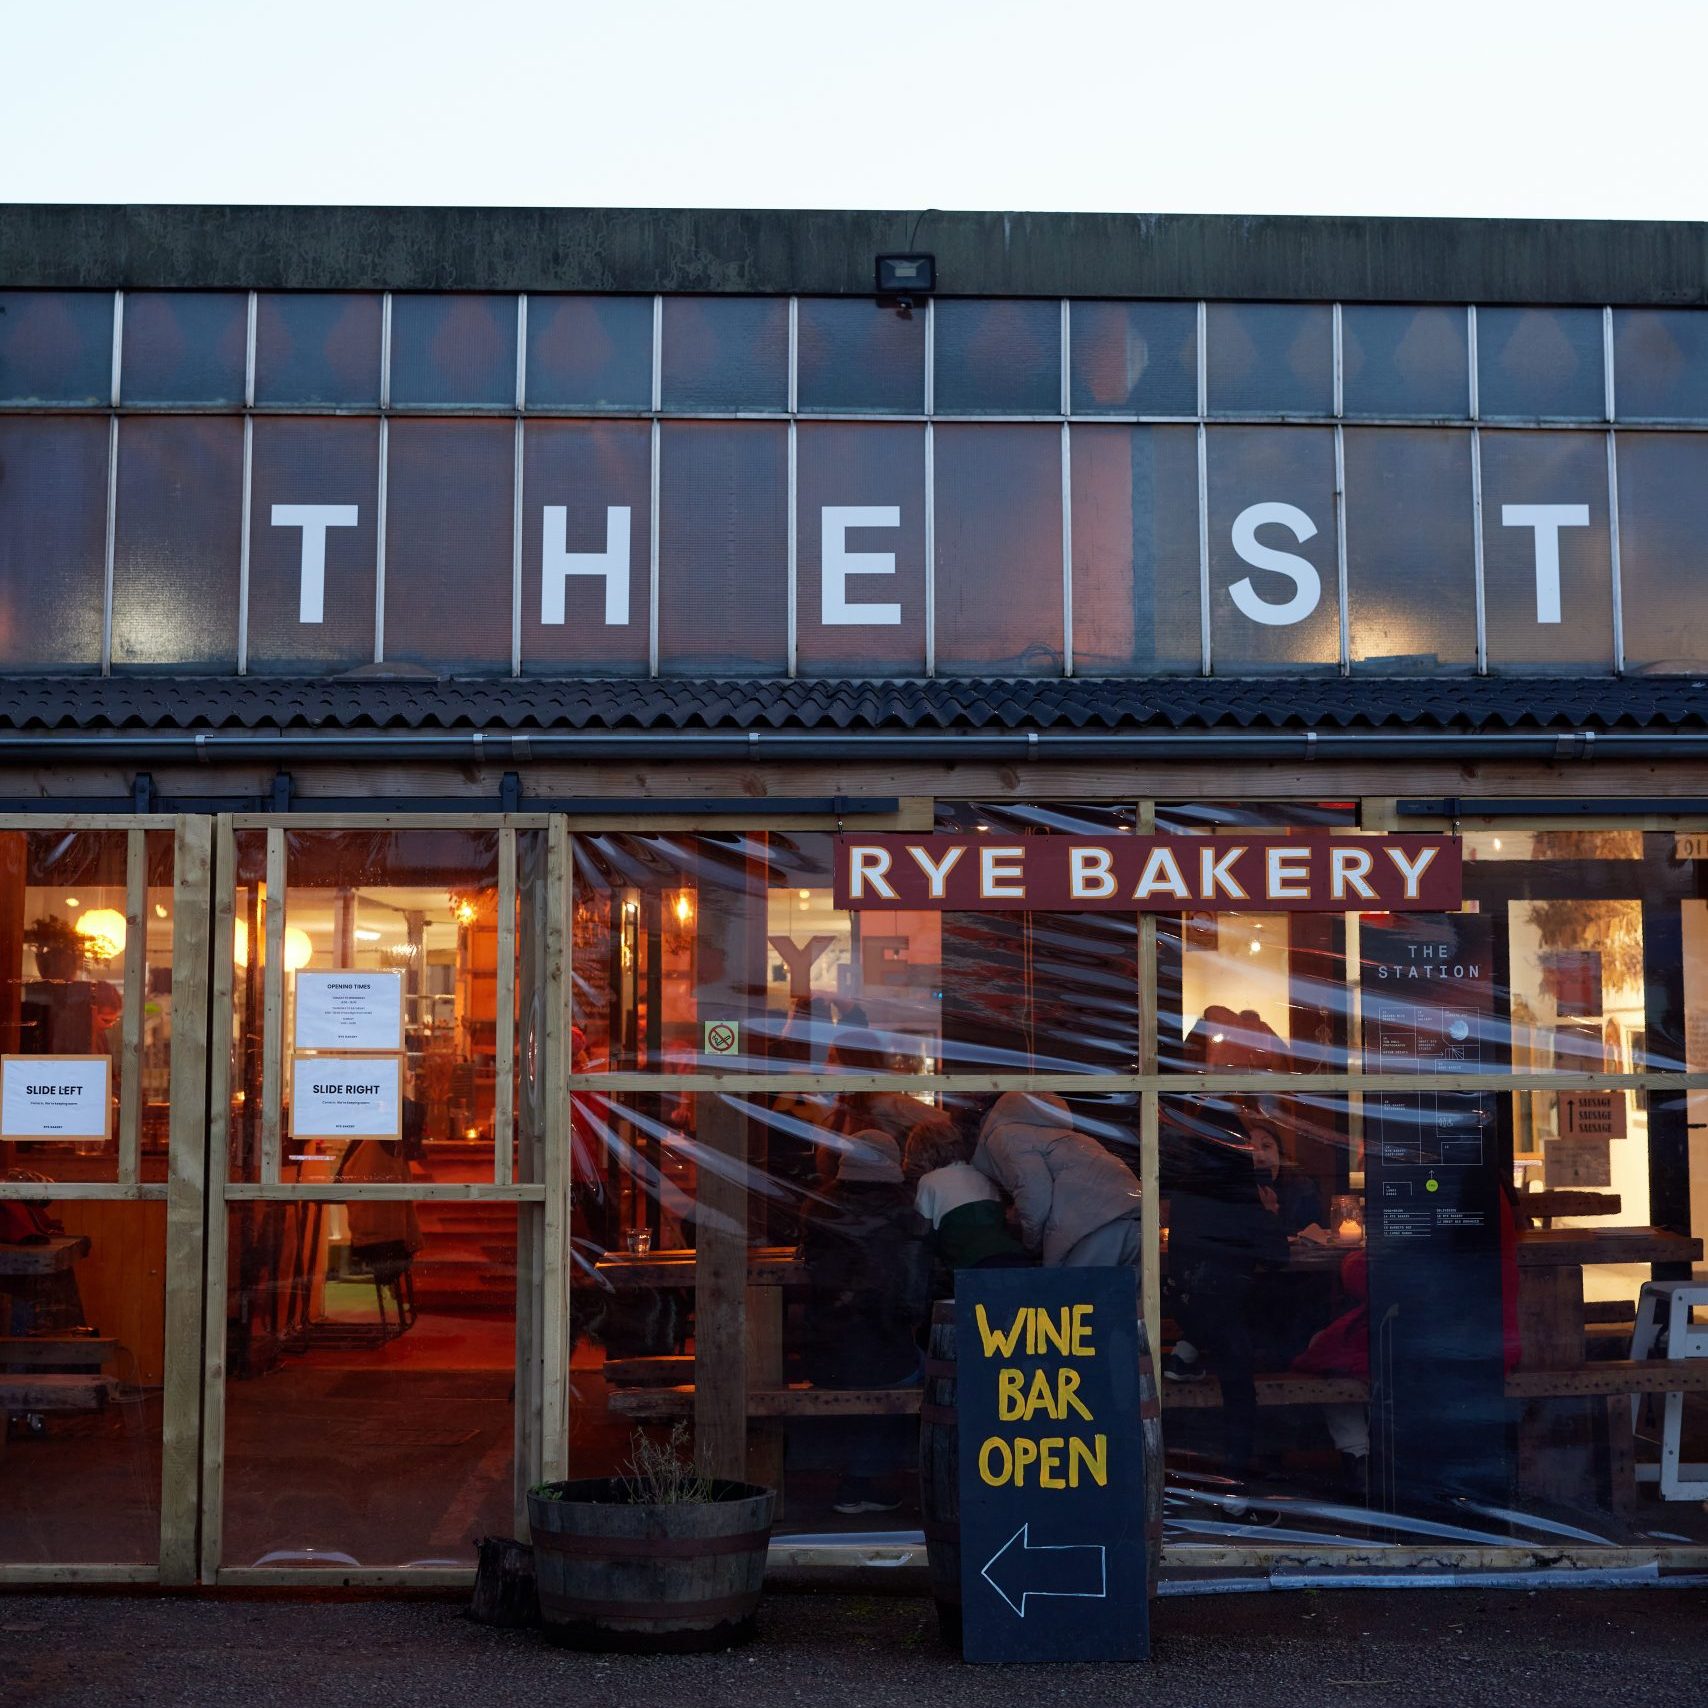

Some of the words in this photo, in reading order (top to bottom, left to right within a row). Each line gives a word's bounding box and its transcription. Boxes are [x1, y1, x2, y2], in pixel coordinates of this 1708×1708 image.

[270, 504, 903, 626] THE
[1229, 502, 1590, 626] ST
[848, 845, 1026, 900] RYE
[1069, 846, 1442, 900] BAKERY
[1408, 945, 1448, 958] THE
[1378, 965, 1479, 979] STATION
[26, 1085, 56, 1095] SLIDE
[58, 1086, 83, 1095] LEFT
[313, 1084, 343, 1094] SLIDE
[345, 1085, 380, 1095] RIGHT
[1579, 1098, 1611, 1107] SAUSAGE
[1579, 1111, 1611, 1120] SAUSAGE
[1579, 1124, 1612, 1133] SAUSAGE
[975, 1304, 1096, 1358] WINE
[999, 1367, 1094, 1421] BAR
[978, 1434, 1108, 1489] OPEN
